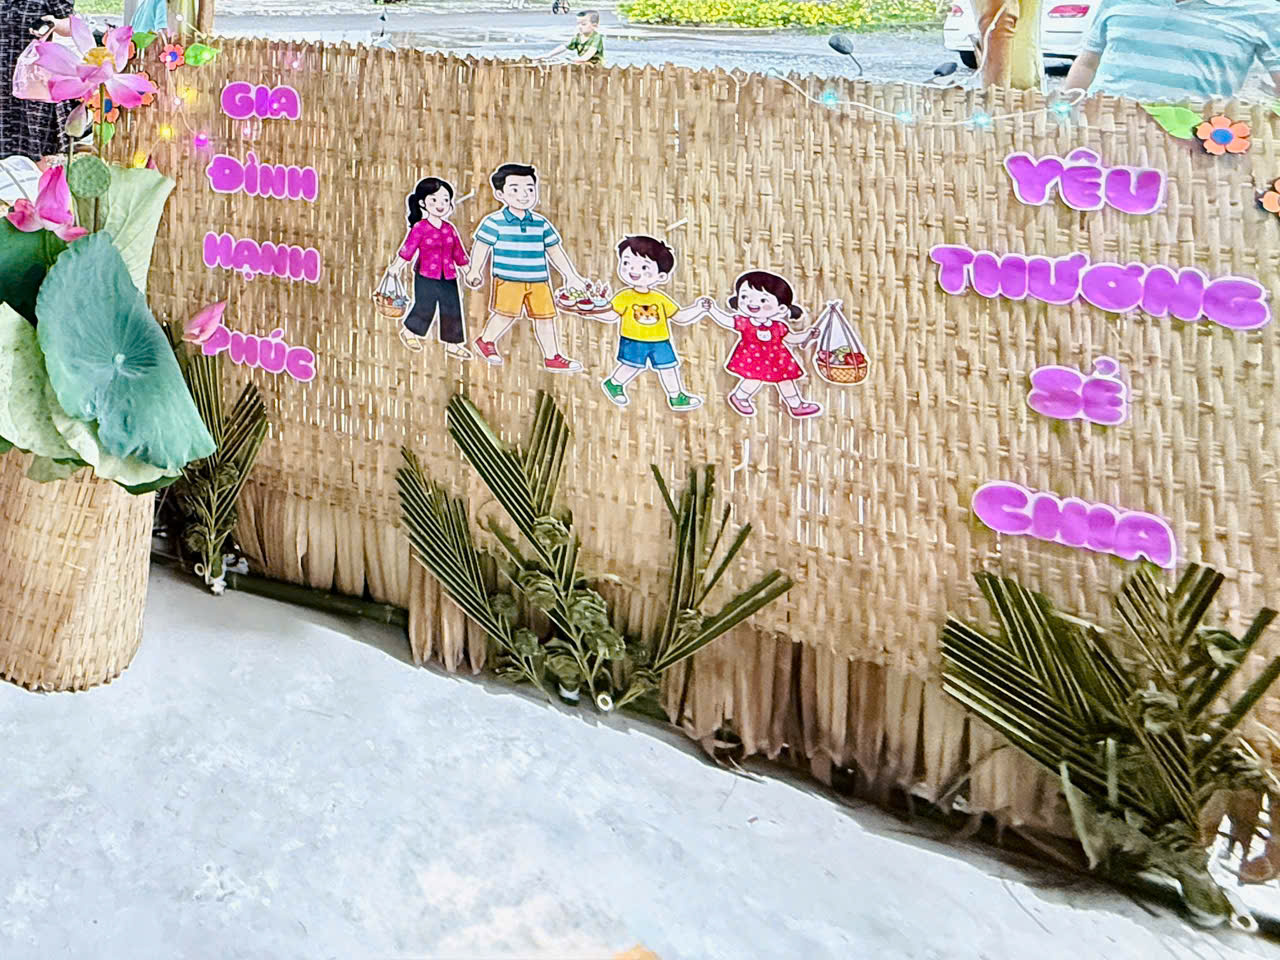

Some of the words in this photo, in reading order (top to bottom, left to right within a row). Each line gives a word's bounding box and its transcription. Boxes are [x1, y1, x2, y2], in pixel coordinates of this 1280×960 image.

[221, 81, 301, 120] GIA
[206, 151, 318, 202] ĐÌNH
[1004, 147, 1166, 214] YÊU
[203, 232, 320, 283] HẠNH
[929, 243, 1272, 329] THƯƠNG
[202, 324, 316, 381] PHÚC
[1027, 355, 1128, 426] SẺ
[972, 480, 1177, 569] CHIA
